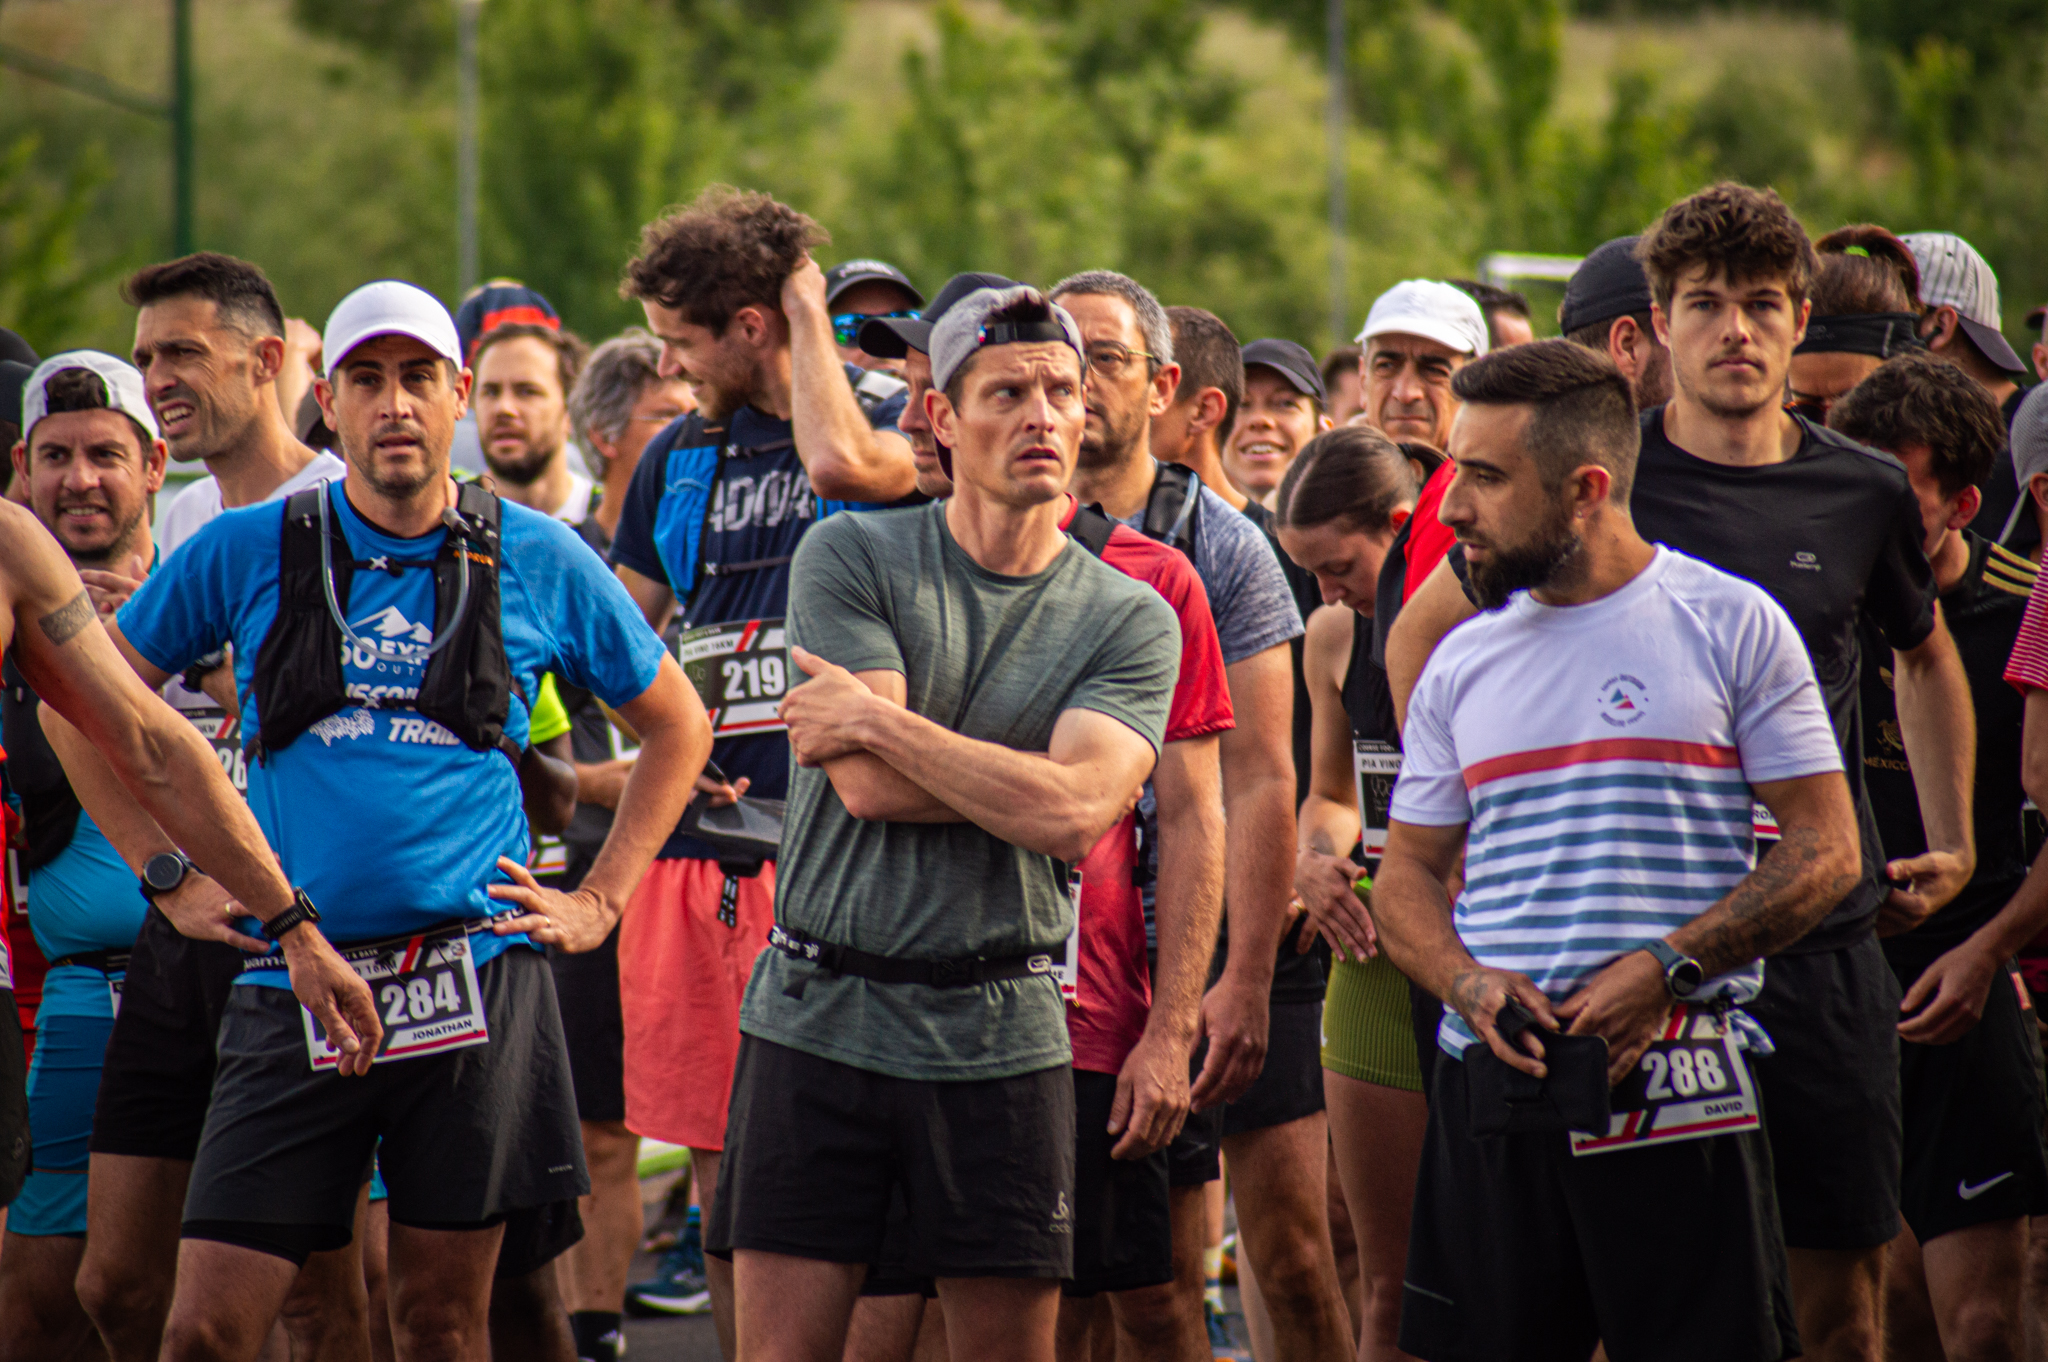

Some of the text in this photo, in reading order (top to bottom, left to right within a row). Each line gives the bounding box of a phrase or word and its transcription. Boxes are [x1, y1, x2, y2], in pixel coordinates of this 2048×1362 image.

[722, 655, 786, 701] 219
[1362, 758, 1377, 769] PIA
[380, 970, 462, 1027] 284
[411, 1018, 473, 1041] JONATHAN
[1641, 1047, 1728, 1100] 288
[1704, 1101, 1743, 1116] DAVID
